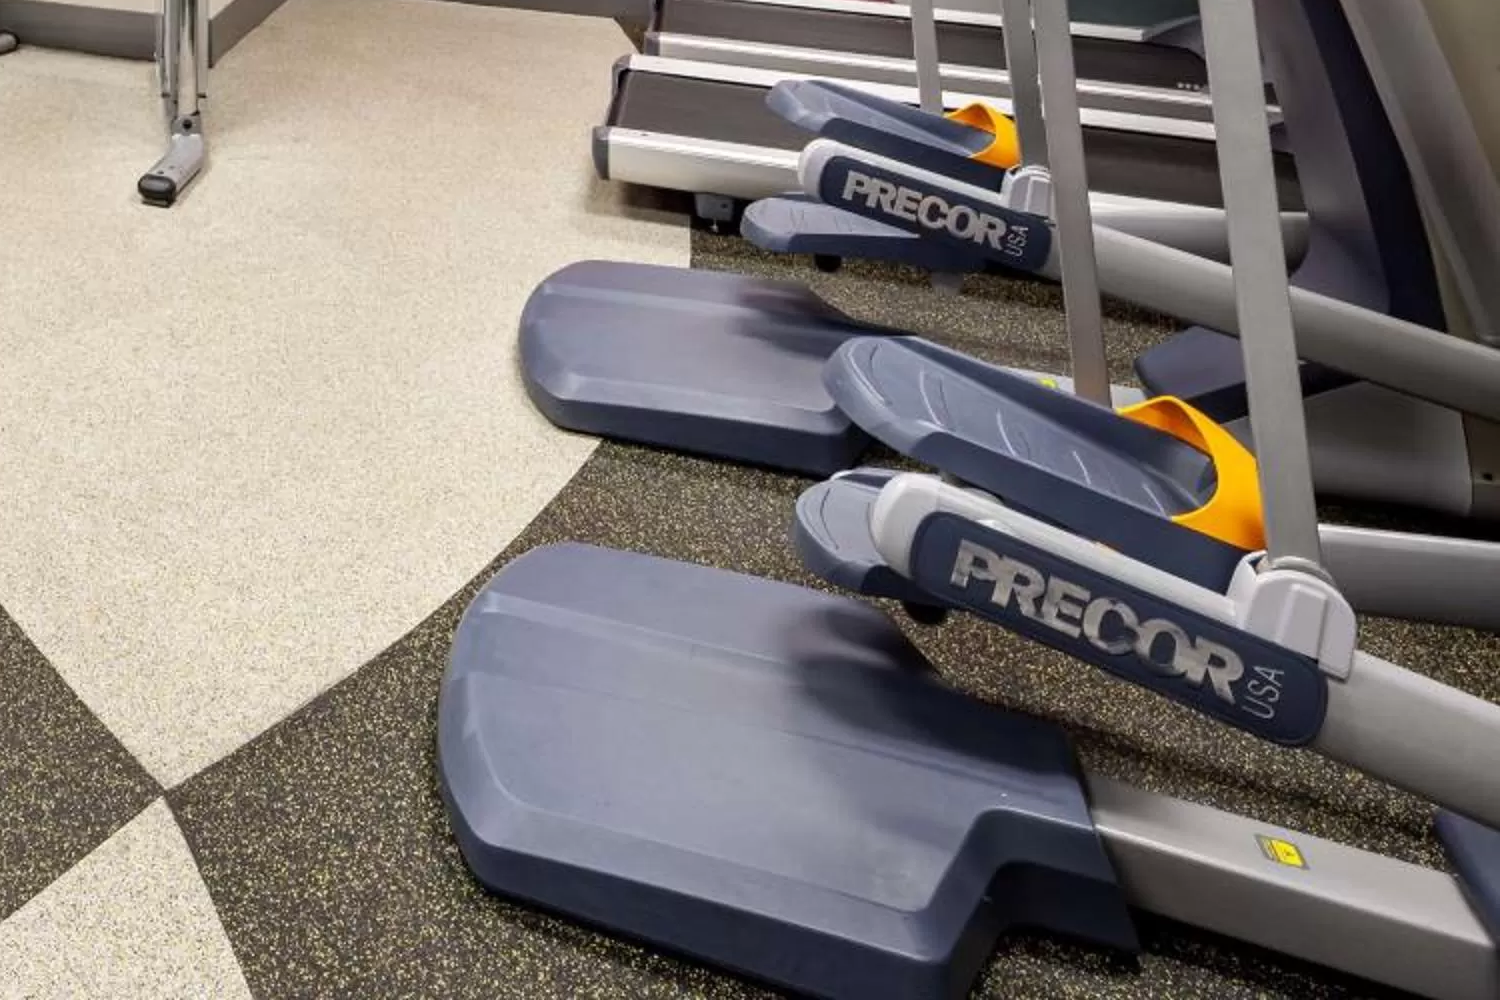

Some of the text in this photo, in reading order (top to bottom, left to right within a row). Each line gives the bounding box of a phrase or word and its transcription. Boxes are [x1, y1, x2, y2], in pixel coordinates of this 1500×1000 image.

[842, 169, 1030, 258] PRECOR USA
[949, 538, 1285, 720] PRECOR USA
